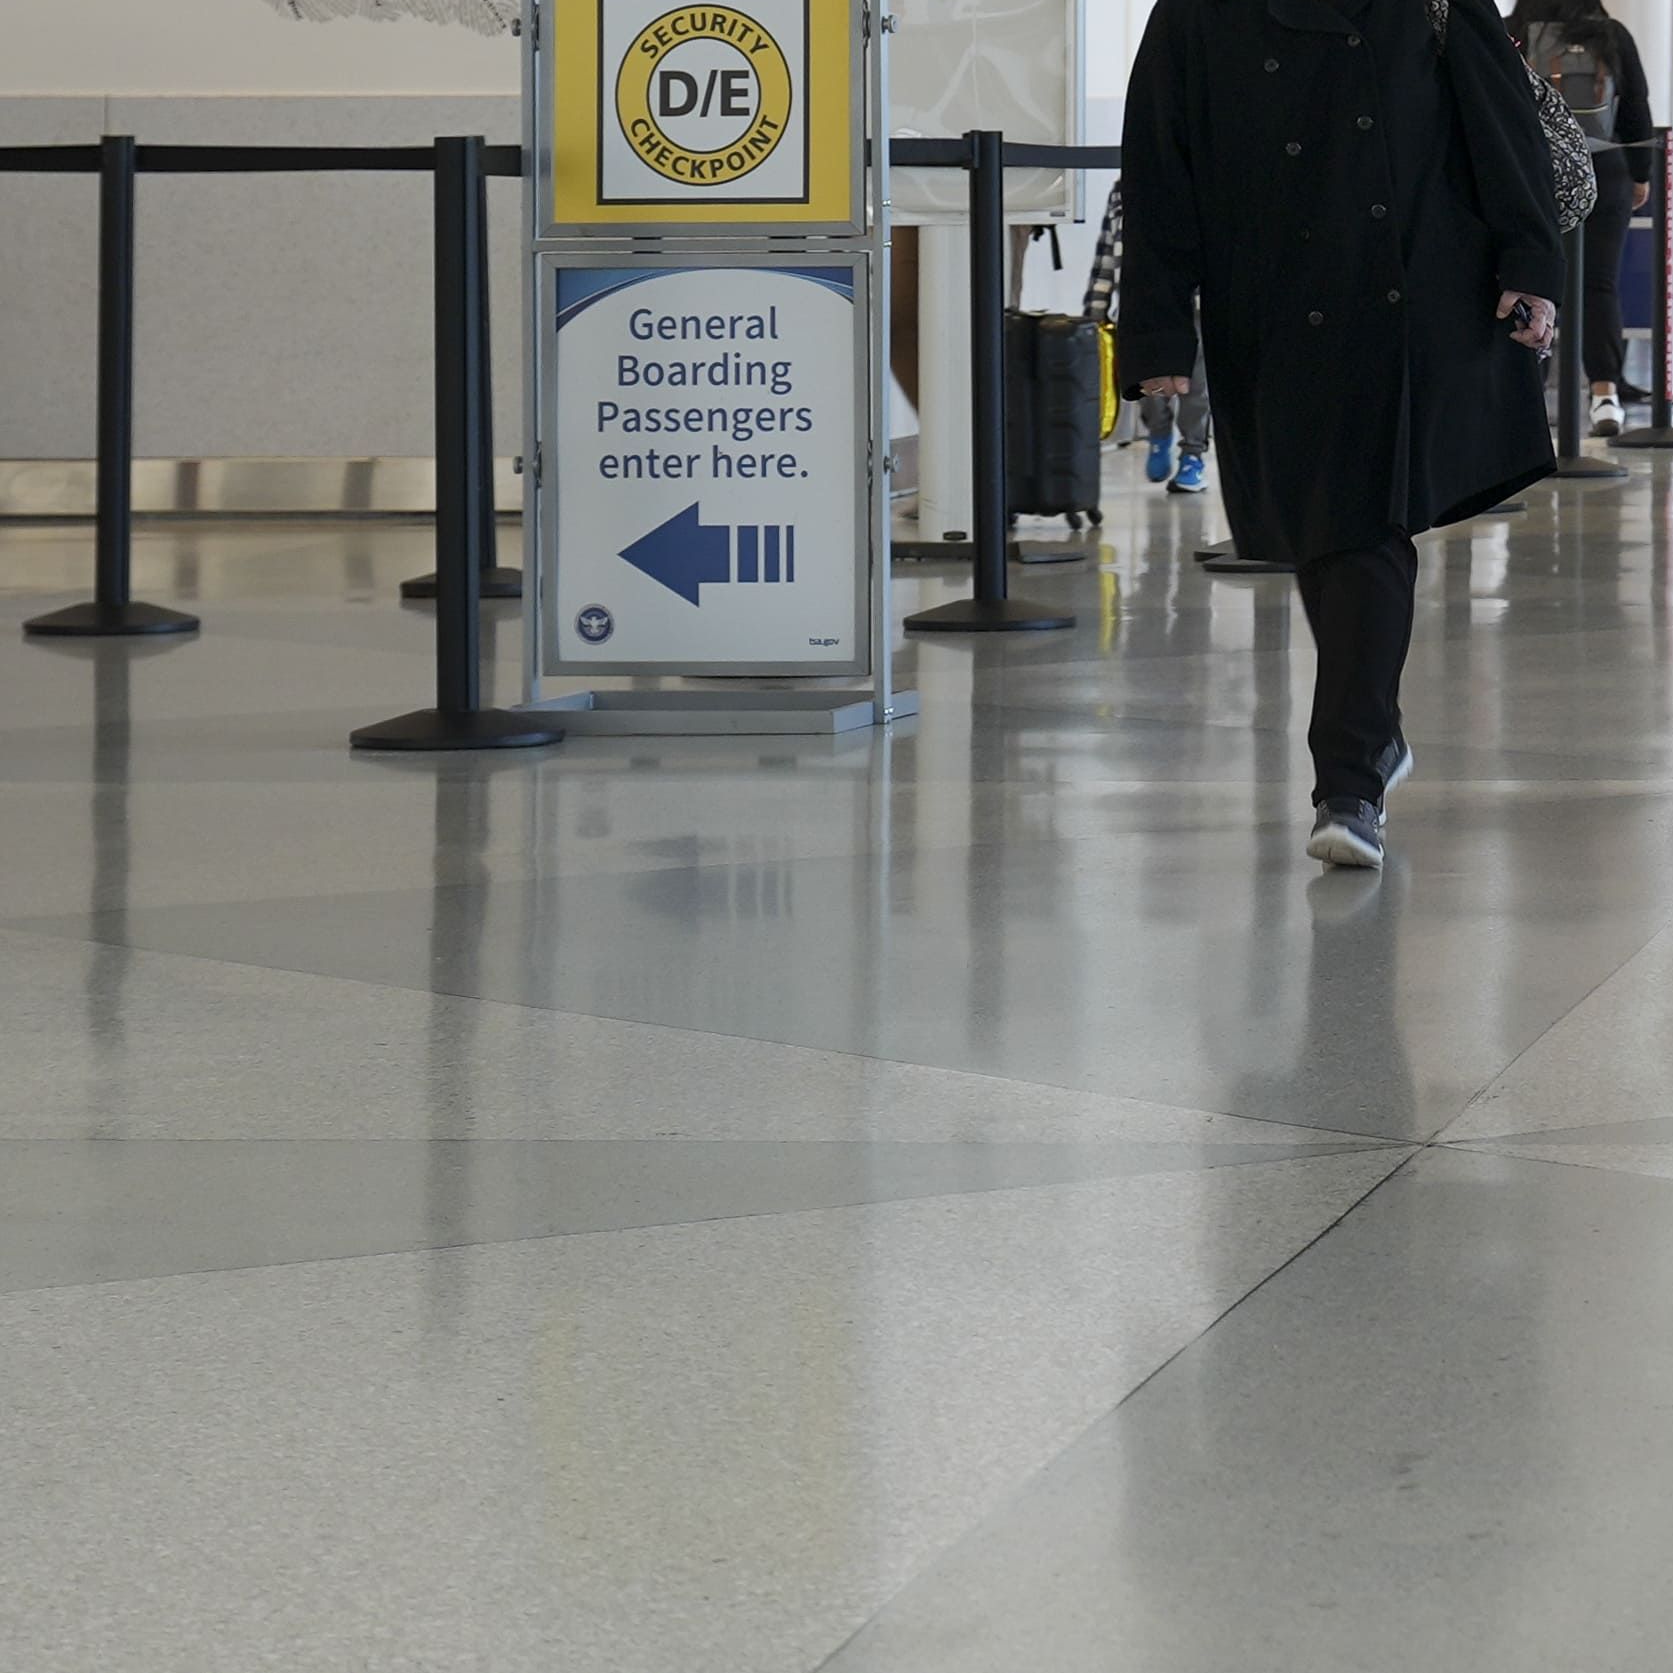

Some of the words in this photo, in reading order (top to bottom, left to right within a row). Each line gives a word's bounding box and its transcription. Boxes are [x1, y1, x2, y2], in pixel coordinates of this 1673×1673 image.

[640, 12, 770, 60] SECURITY
[658, 69, 751, 118] D/E
[630, 114, 780, 180] CHECKPOINT
[628, 306, 779, 341] General
[617, 352, 793, 394] Boarding
[597, 402, 813, 441] Passengers
[599, 446, 701, 479] enter
[712, 445, 809, 479] here.
